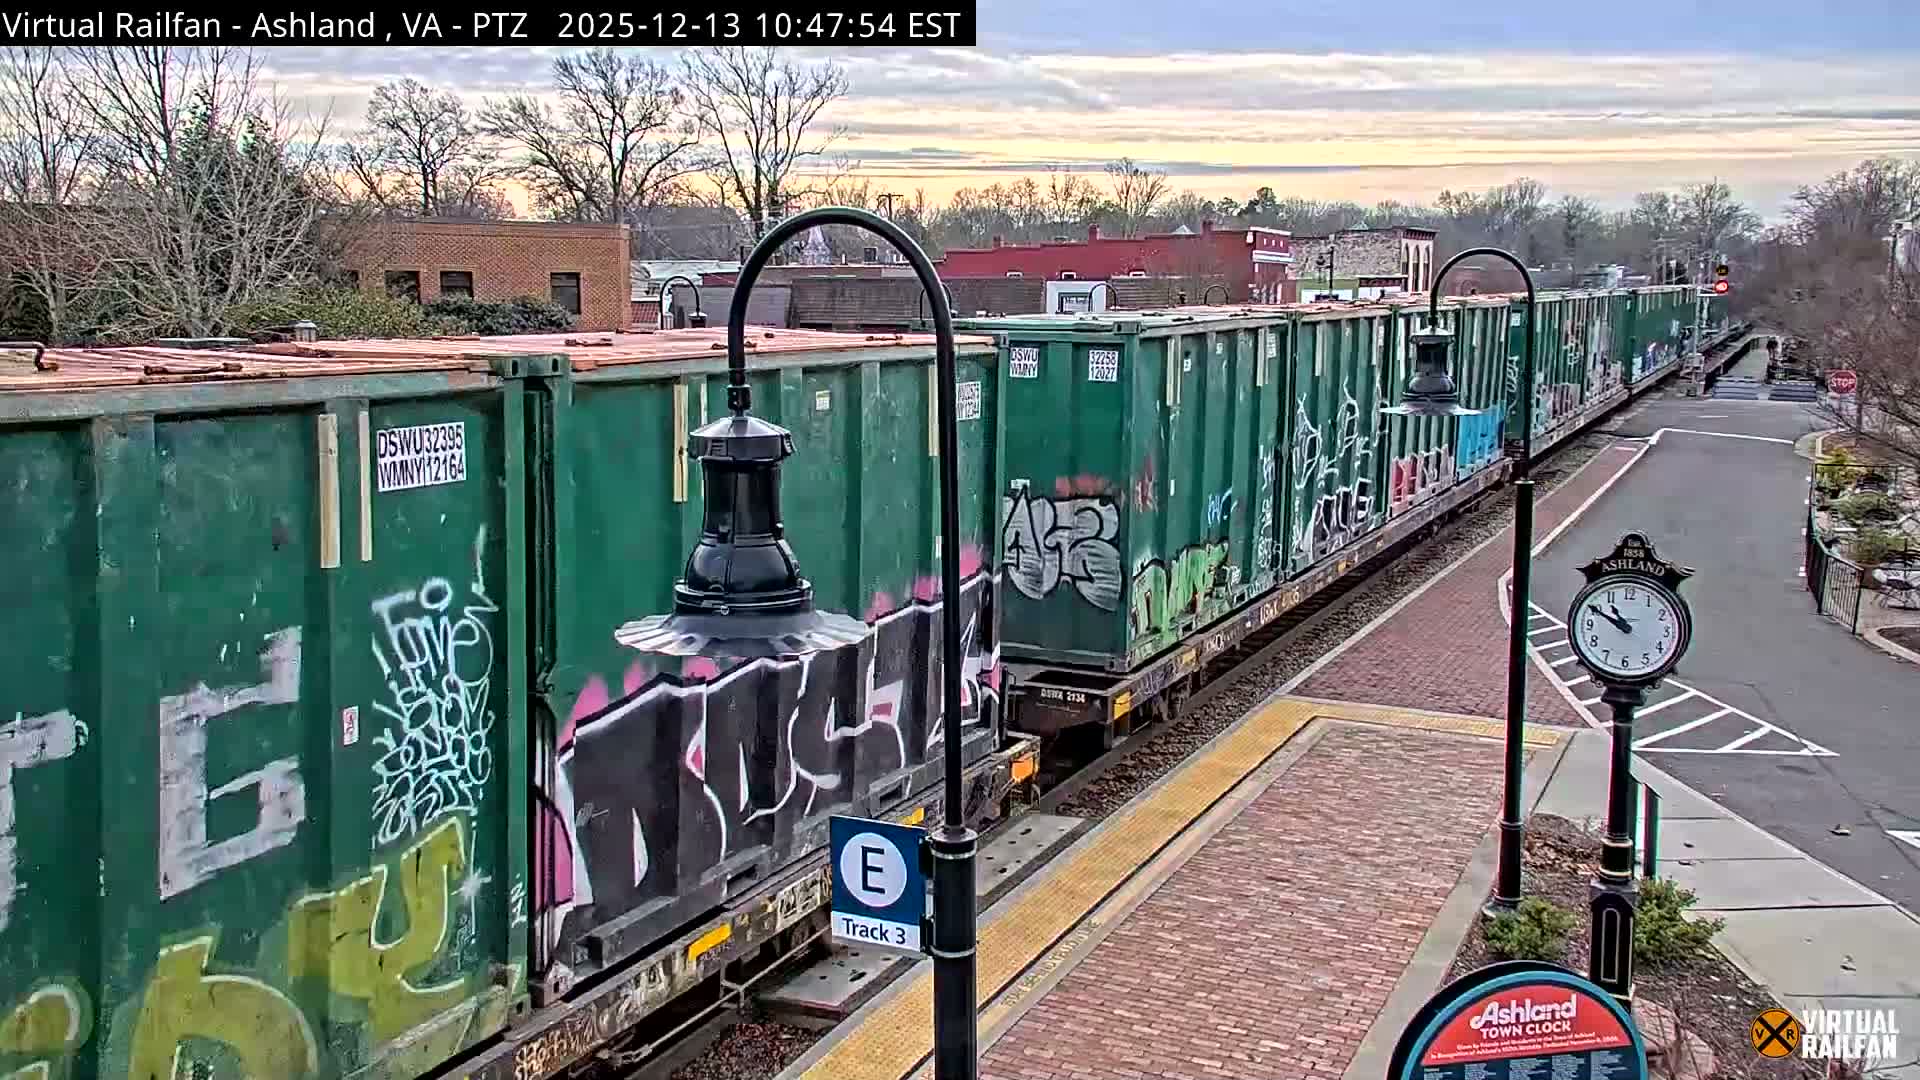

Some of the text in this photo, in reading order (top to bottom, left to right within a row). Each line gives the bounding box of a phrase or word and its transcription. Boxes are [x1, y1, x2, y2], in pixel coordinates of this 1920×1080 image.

[1831, 377, 1856, 388] STOP
[1601, 558, 1666, 577] ASHLAND
[1624, 587, 1635, 601] 12
[1658, 608, 1666, 621] 2
[1586, 618, 1594, 631] 9
[1590, 634, 1598, 648] 8
[1655, 640, 1664, 654] 4
[1601, 649, 1610, 662] 7
[1621, 655, 1629, 668] 6
[1641, 653, 1650, 665] 5
[861, 845, 886, 895] E
[842, 917, 906, 945] Track 3
[1469, 992, 1577, 1030] Ashland
[1480, 1020, 1571, 1039] TOWN CLOCK
